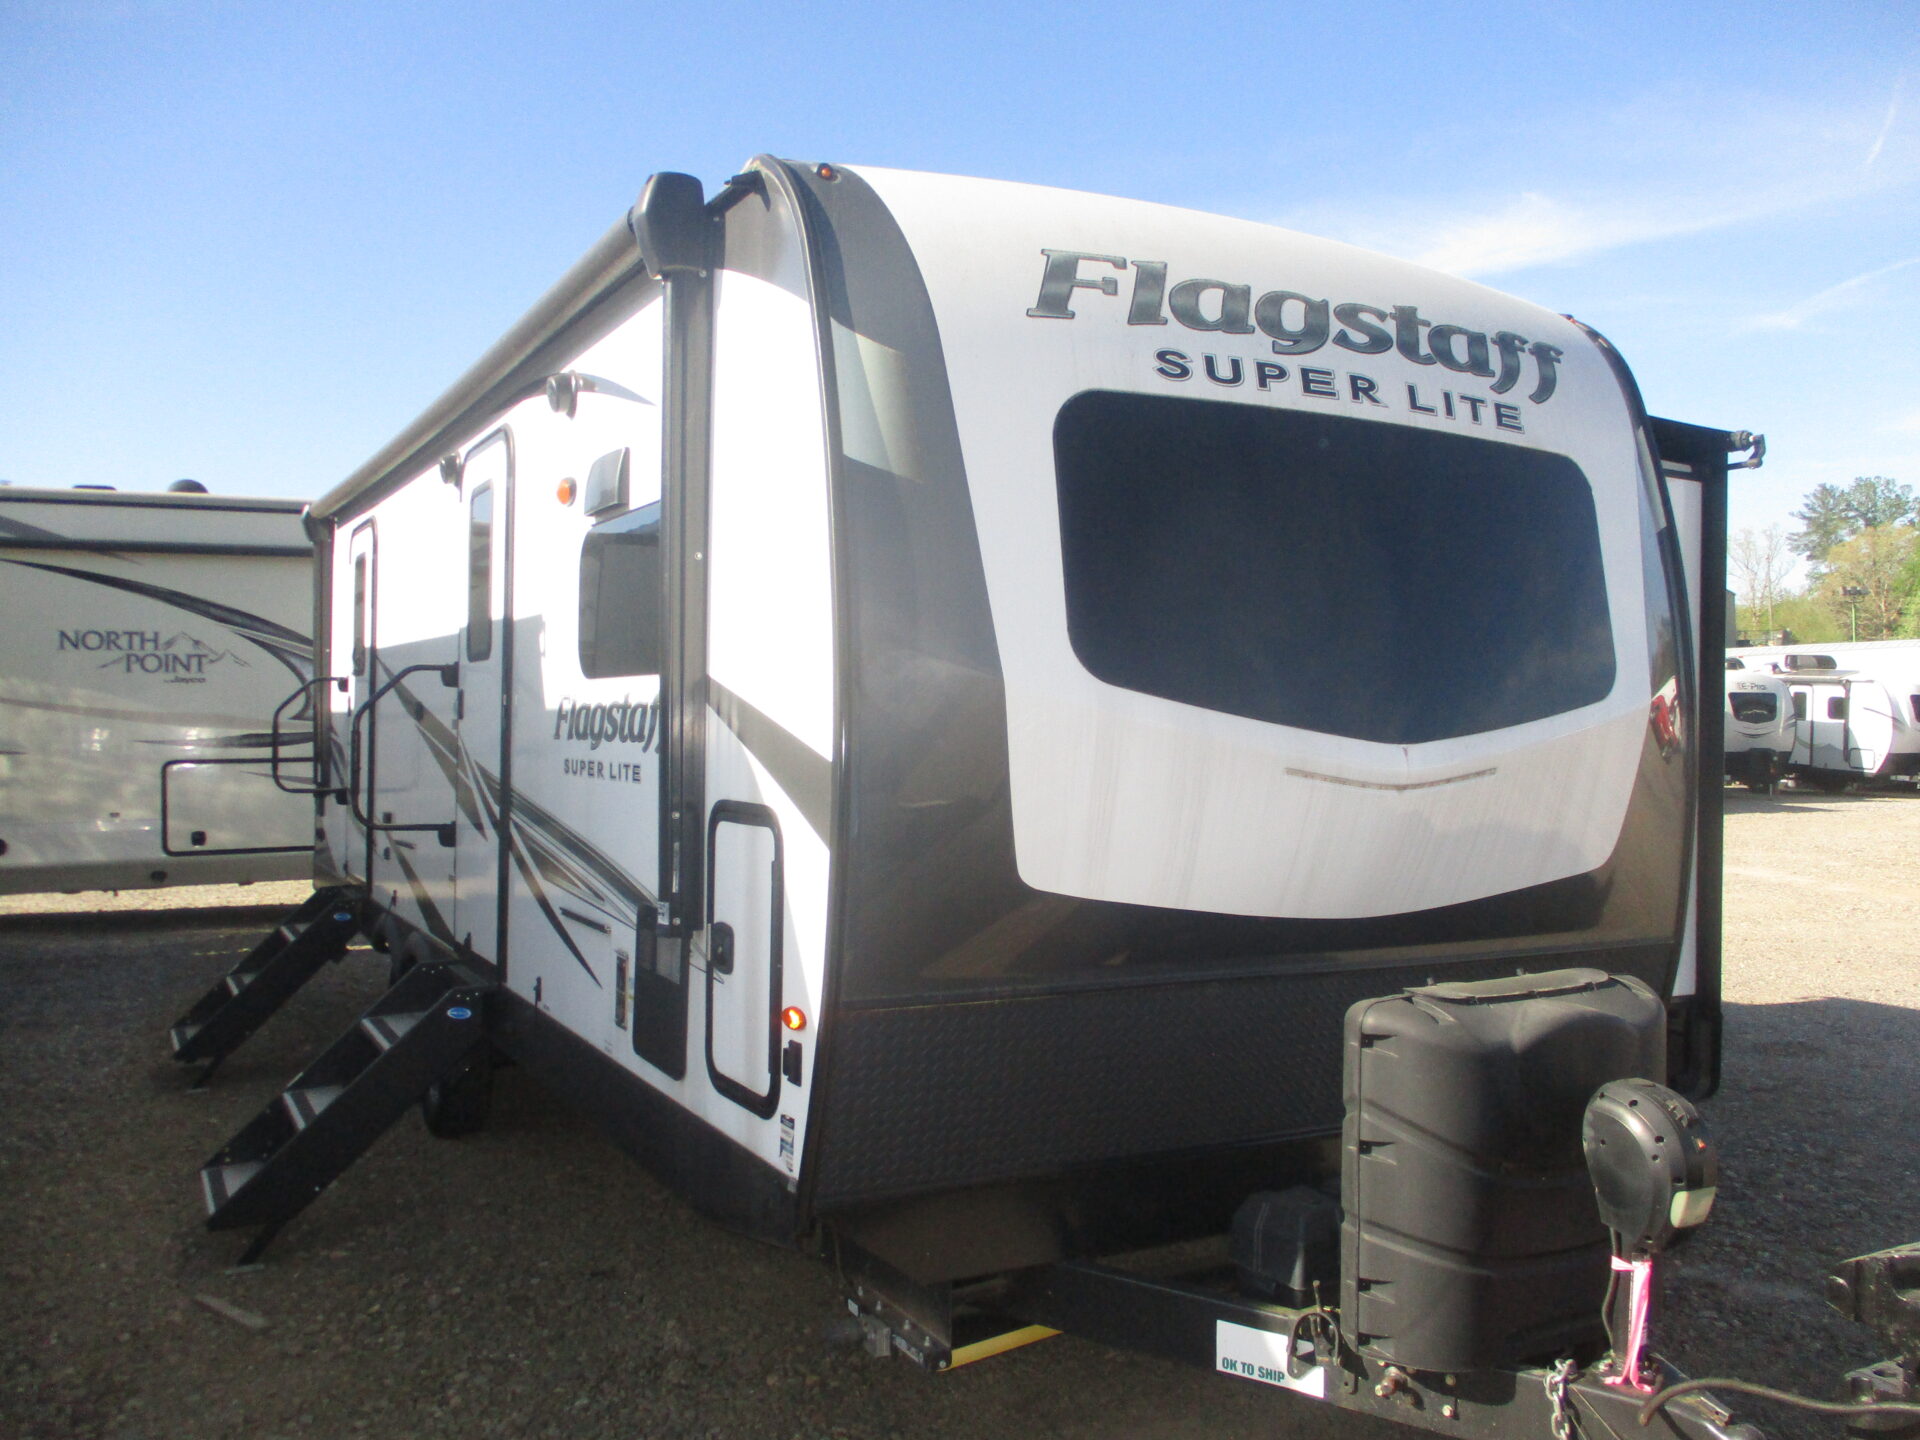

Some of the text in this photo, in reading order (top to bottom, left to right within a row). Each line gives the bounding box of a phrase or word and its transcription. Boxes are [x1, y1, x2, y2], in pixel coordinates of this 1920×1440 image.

[1026, 249, 1564, 404] Flagstaff
[1153, 347, 1525, 434] SUPER LITE
[59, 630, 160, 650] NORTH
[125, 653, 208, 673] POINT
[554, 694, 660, 754] Flagstaf
[563, 758, 642, 783] SUPER LITE
[1222, 1357, 1285, 1383] OK TO SHIP
